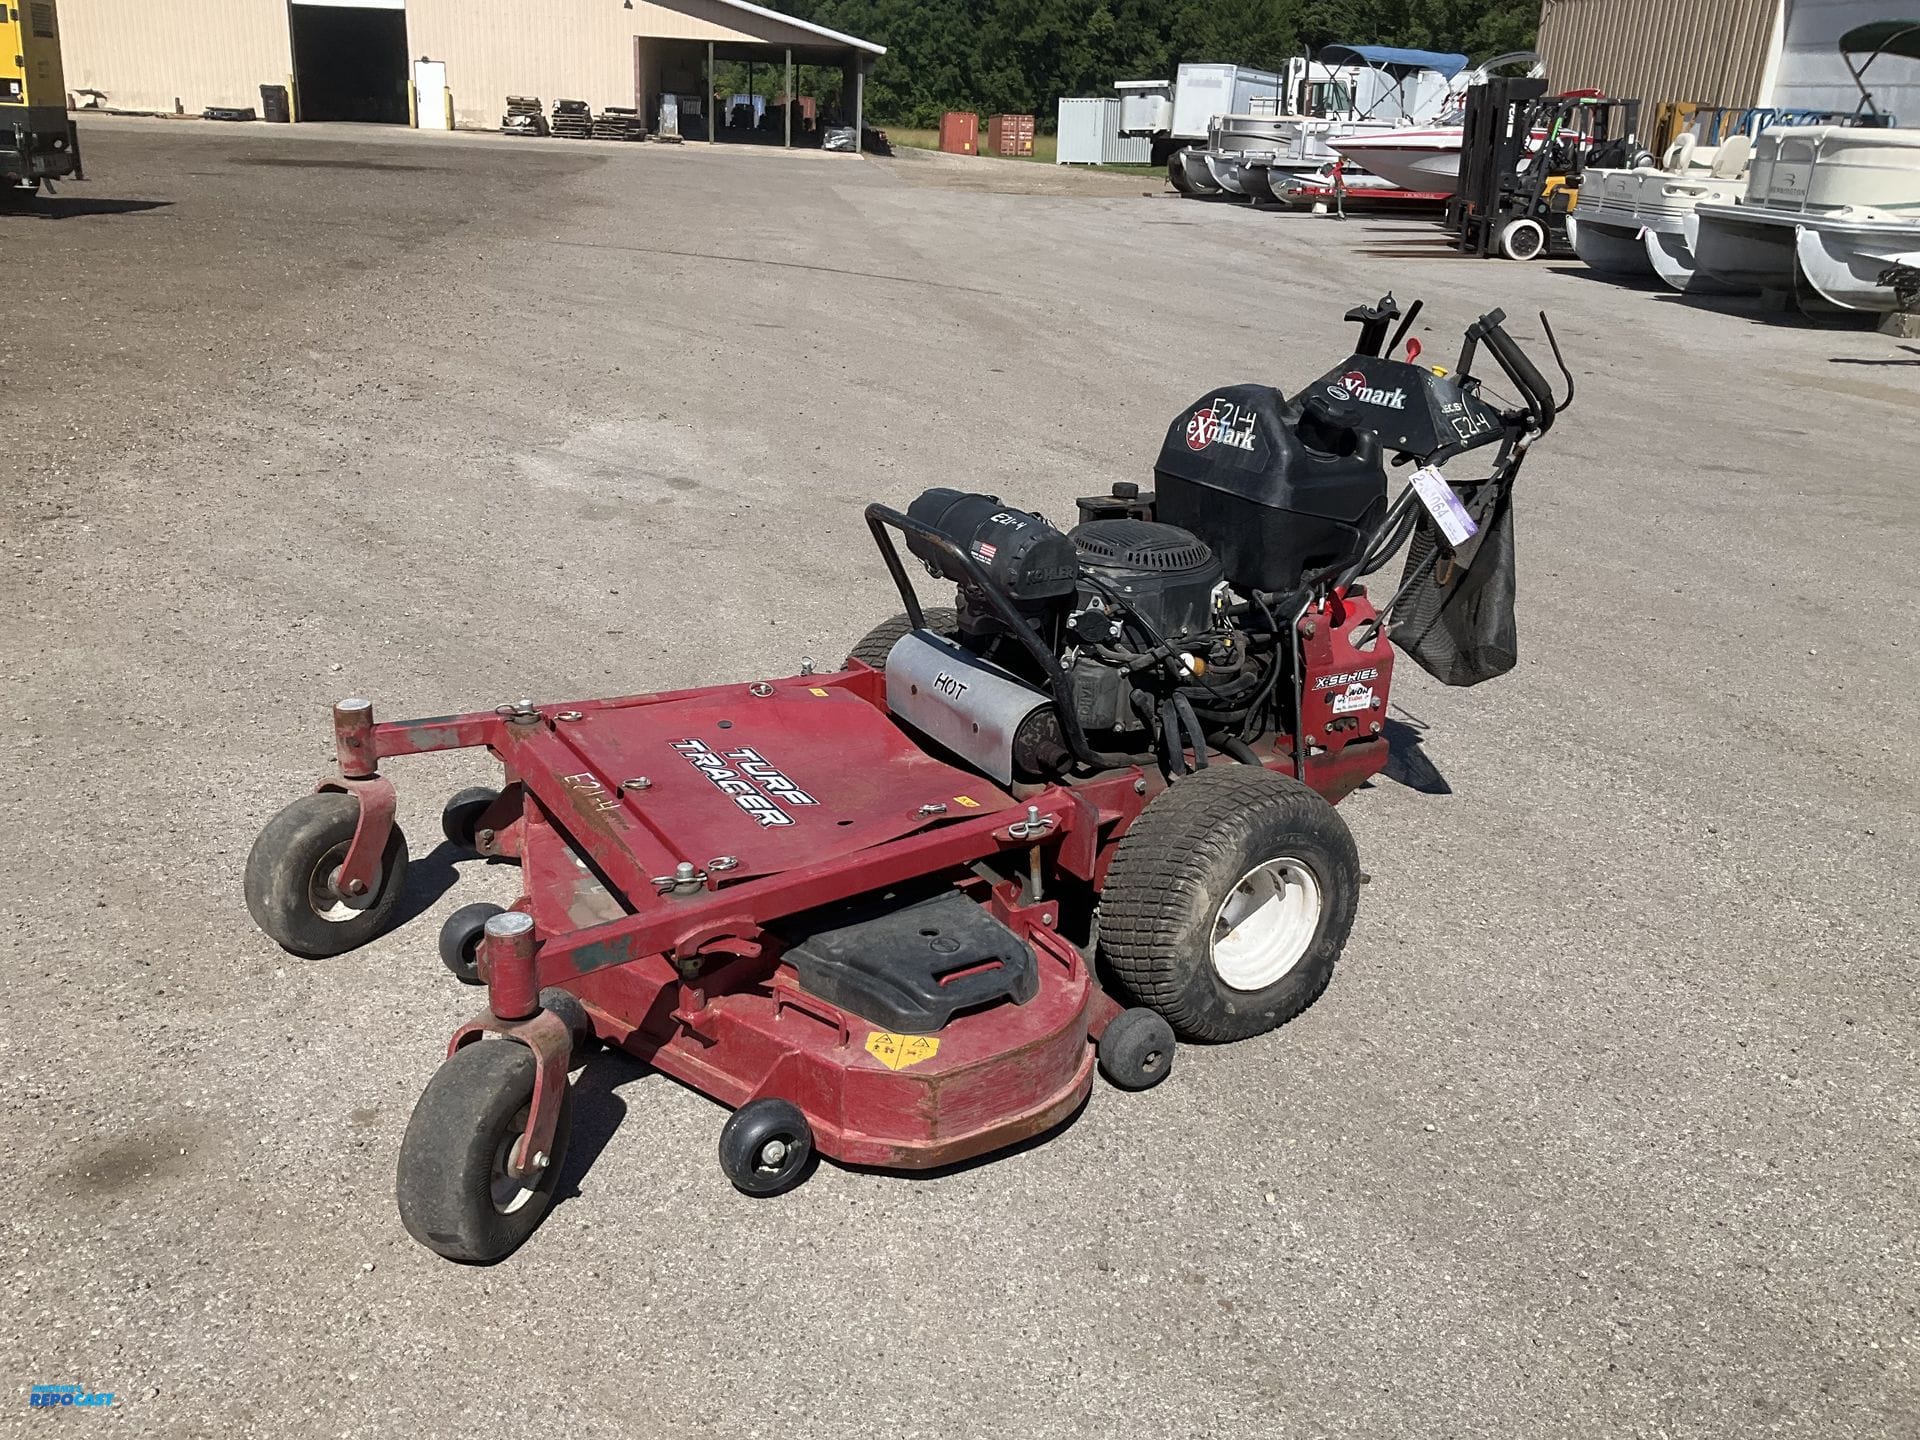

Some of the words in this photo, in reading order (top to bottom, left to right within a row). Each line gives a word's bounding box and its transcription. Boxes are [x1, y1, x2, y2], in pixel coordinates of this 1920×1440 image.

[1210, 398, 1257, 433] E21-4
[1451, 392, 1491, 438] E21-4
[990, 513, 1028, 531] E21-4
[934, 672, 968, 700] HOT
[1315, 668, 1379, 689] X-SERIES
[564, 772, 621, 811] E21-4
[671, 739, 795, 828] TRACER
[723, 747, 818, 805] TURF
